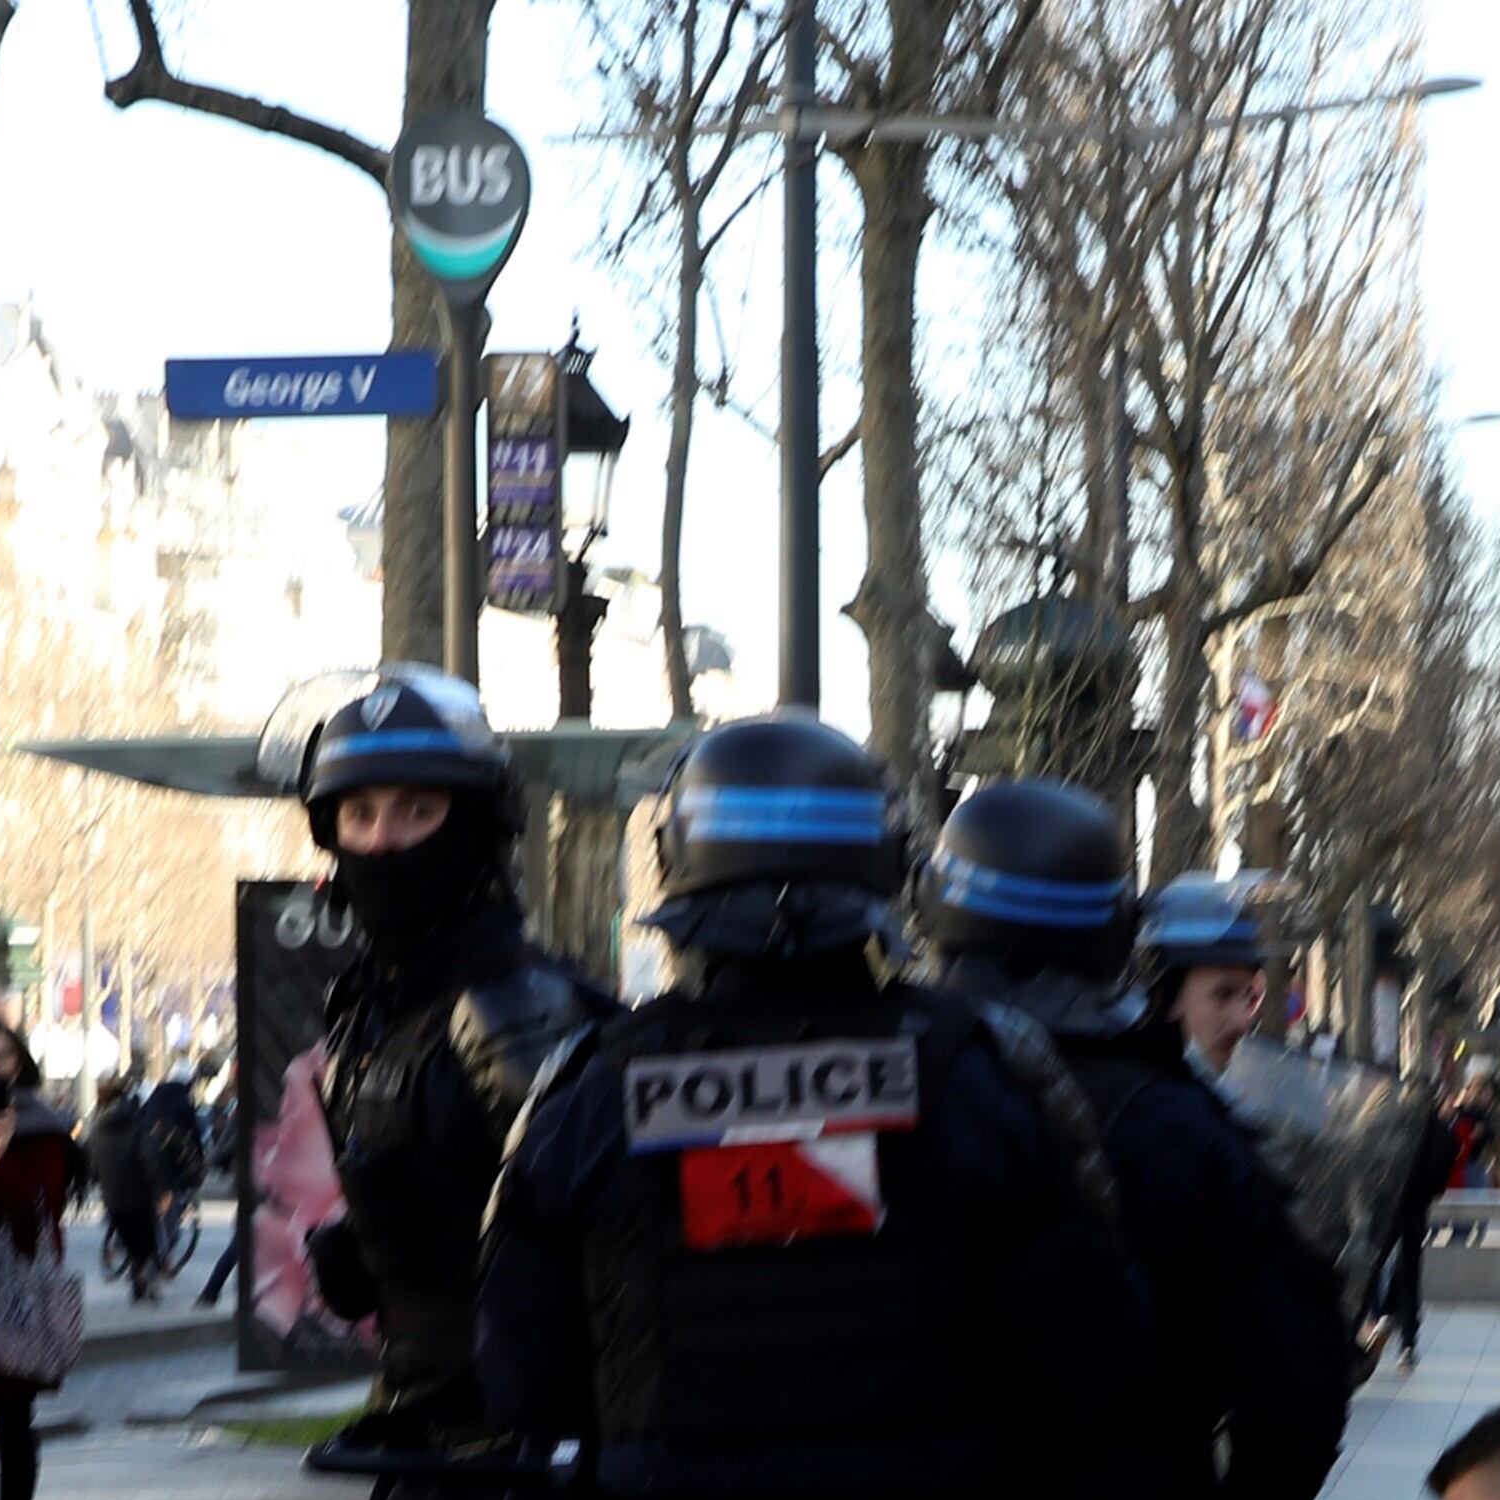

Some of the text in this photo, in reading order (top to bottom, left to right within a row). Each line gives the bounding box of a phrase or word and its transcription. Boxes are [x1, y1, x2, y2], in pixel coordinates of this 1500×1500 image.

[410, 143, 512, 207] BUS
[223, 363, 377, 413] George V
[633, 1051, 912, 1126] POLICE
